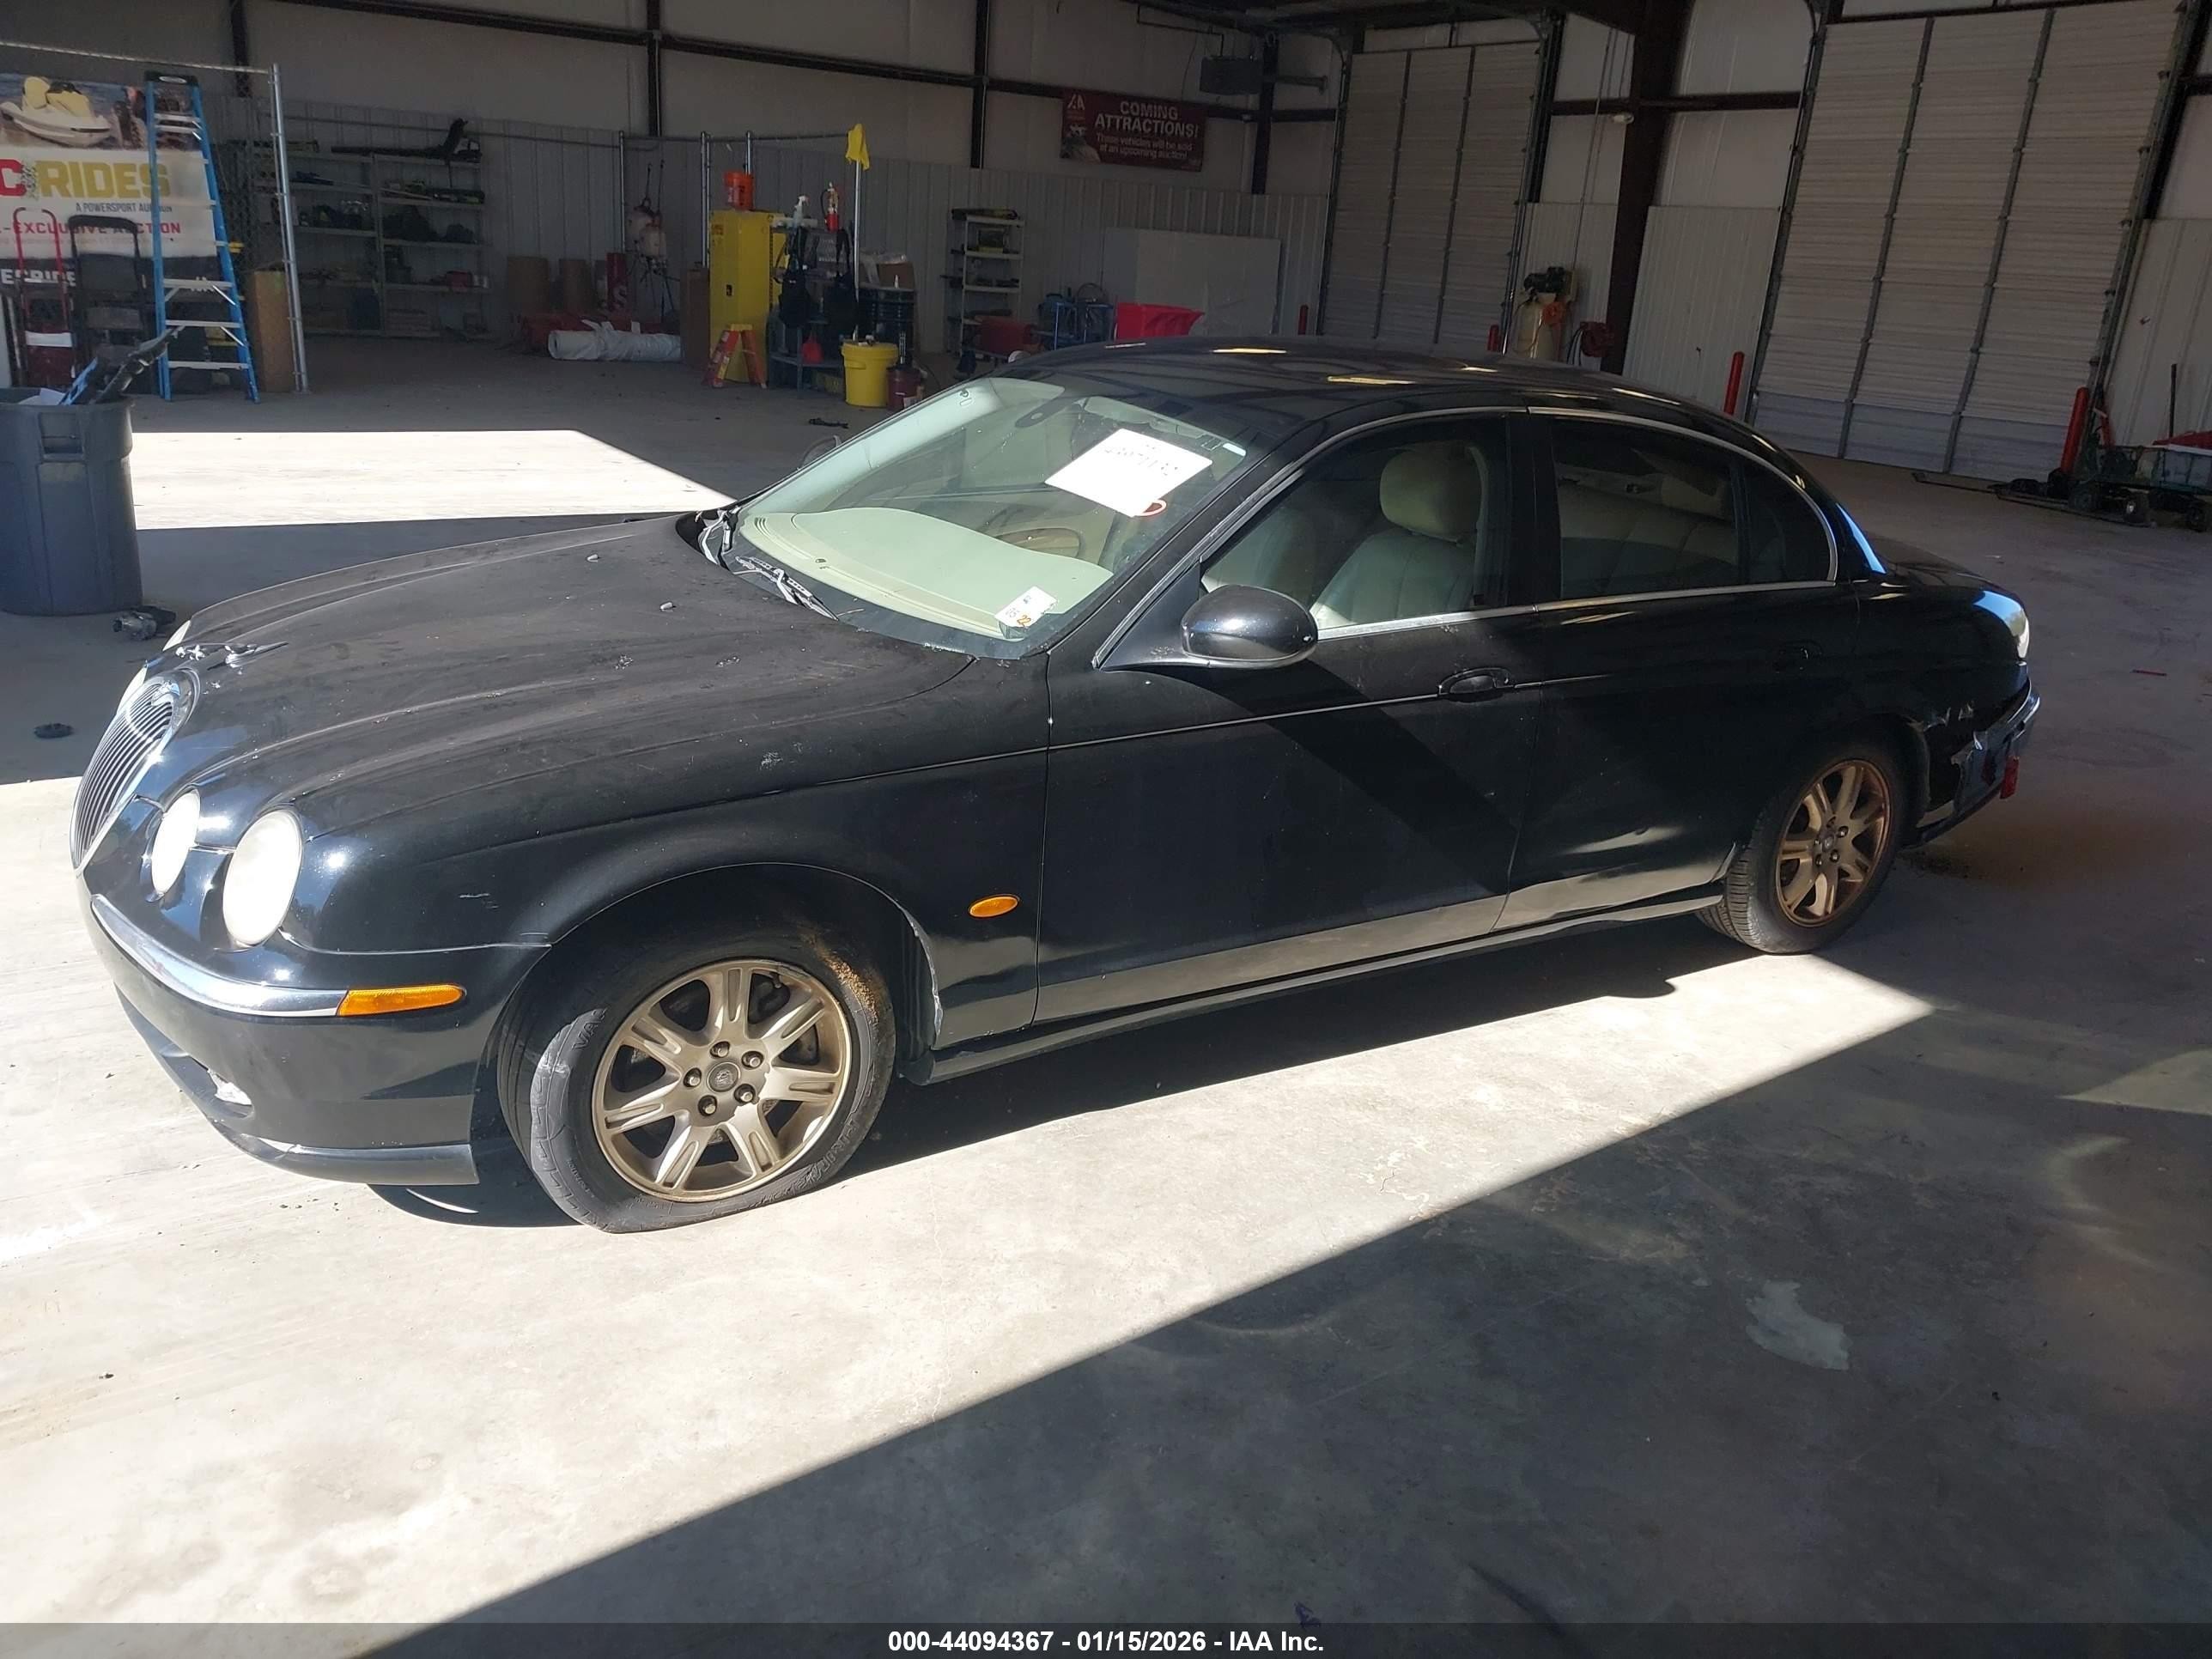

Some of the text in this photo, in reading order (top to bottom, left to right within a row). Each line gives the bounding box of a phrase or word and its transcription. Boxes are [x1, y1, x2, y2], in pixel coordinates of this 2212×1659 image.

[1120, 100, 1179, 120] COMING
[1094, 113, 1199, 138] ATTRACTIONS!
[1121, 136, 1152, 149] vehicles
[1152, 138, 1165, 149] will
[1166, 141, 1176, 150] be
[1177, 142, 1193, 152] sold
[1120, 147, 1157, 160] upcoming
[1158, 149, 1188, 159] auction!
[36, 161, 171, 198] RIDES
[76, 203, 83, 212] A
[83, 203, 135, 213] POWERSPORT
